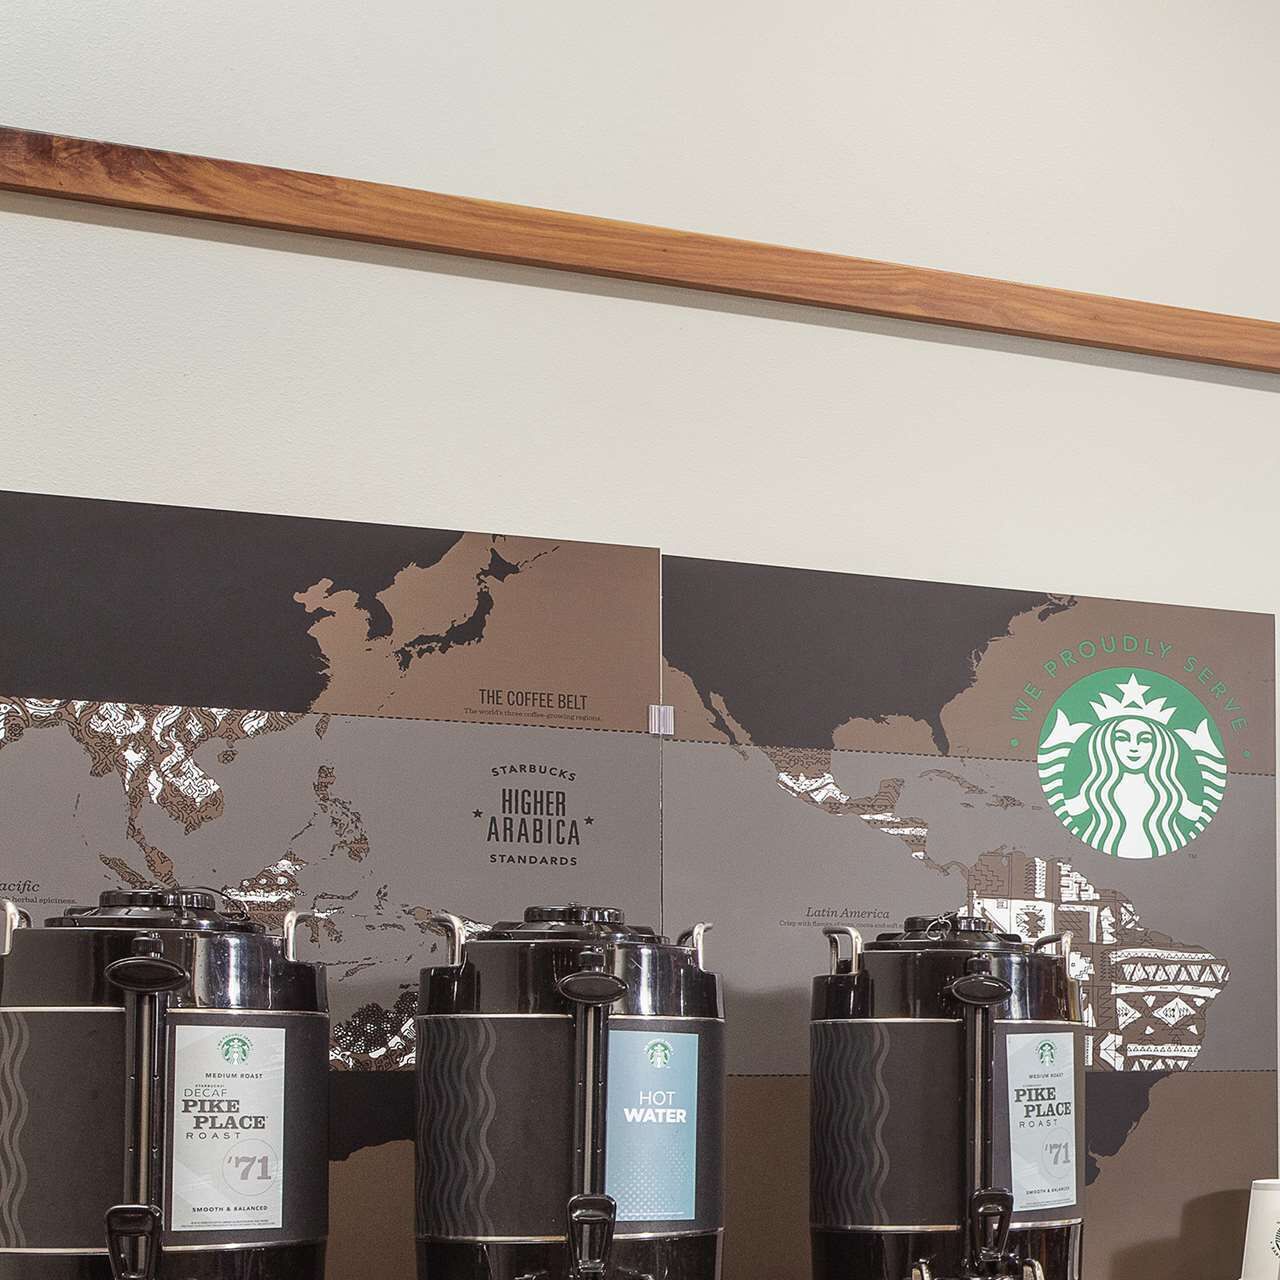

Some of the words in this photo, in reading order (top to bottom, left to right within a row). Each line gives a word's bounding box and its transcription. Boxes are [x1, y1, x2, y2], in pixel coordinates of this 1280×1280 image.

[1012, 682, 1044, 722] WE
[1043, 635, 1174, 678] PROUDLY
[1183, 655, 1248, 732] SERVE
[479, 688, 503, 706] THE
[506, 690, 554, 709] COFFEE
[558, 694, 588, 710] BELT
[491, 763, 576, 781] STARBUCKS
[501, 788, 566, 816] HIGHER
[486, 816, 580, 846] ARABICA
[489, 854, 577, 866] STANDARDS
[0, 880, 40, 894] acific
[806, 906, 838, 918] Latin
[839, 908, 890, 919] America
[184, 1088, 227, 1097] DECAF
[639, 1091, 676, 1106] HOT
[1014, 1087, 1056, 1103] PIKE
[181, 1099, 240, 1114] PIKE
[1023, 1102, 1071, 1118] PLACE
[193, 1115, 266, 1130] PLACE
[623, 1108, 687, 1124] WATER
[1019, 1119, 1058, 1128] ROAST
[186, 1132, 241, 1140] ROAST
